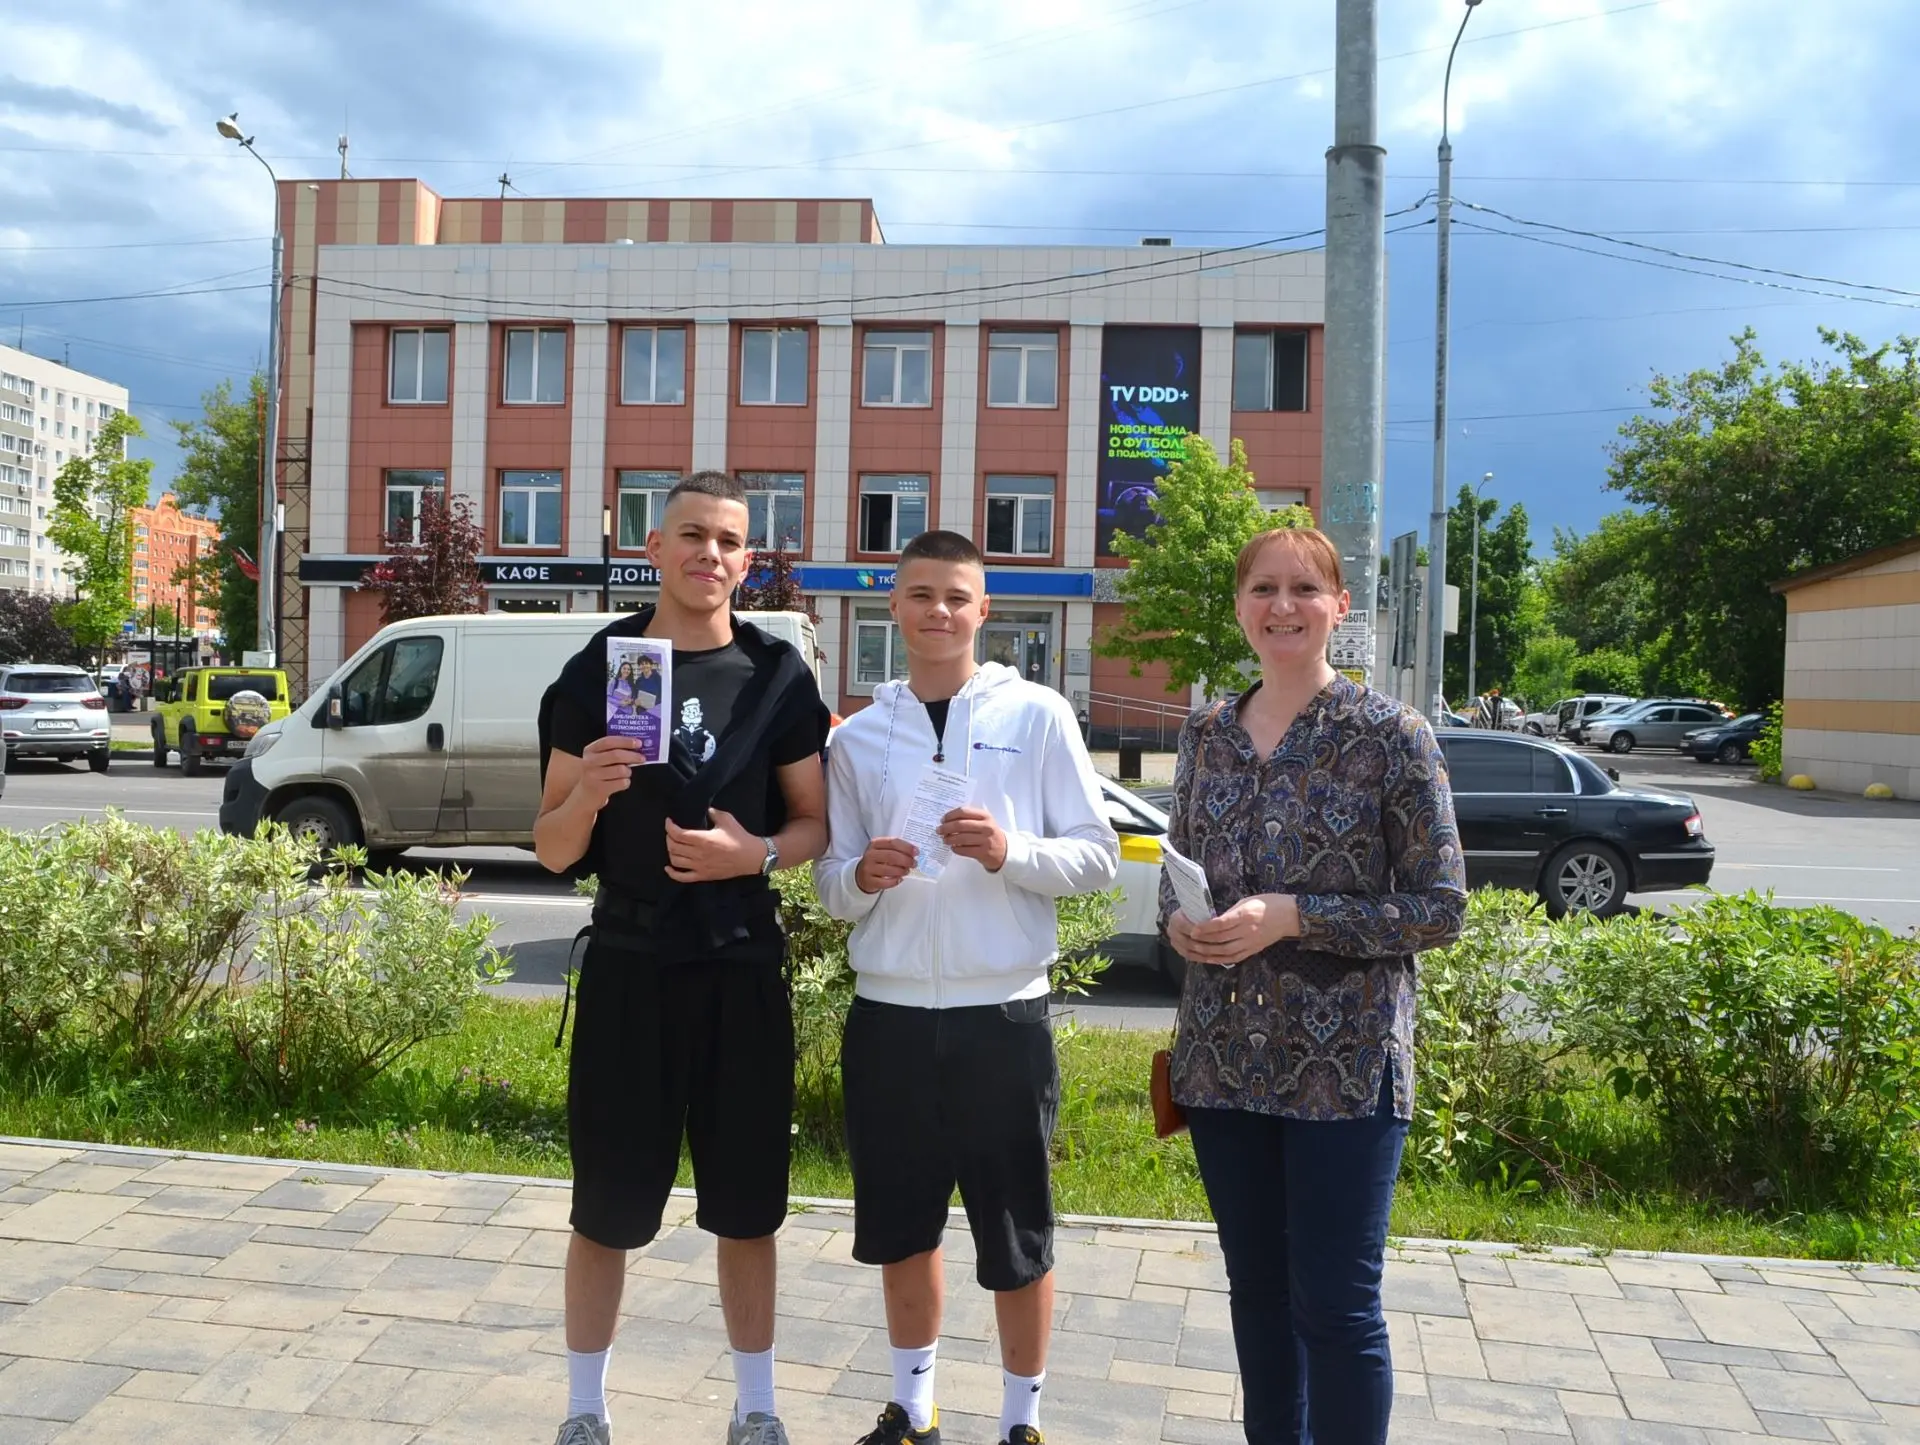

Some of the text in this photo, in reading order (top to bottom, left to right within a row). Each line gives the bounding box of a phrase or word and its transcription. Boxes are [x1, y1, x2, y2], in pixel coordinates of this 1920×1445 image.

[1110, 386, 1190, 403] TV DDD+
[1109, 424, 1187, 435] НОВОЕ МЕДИА
[1109, 436, 1121, 448] О
[1108, 449, 1188, 459] В ПОДМОСКОВЬЕ
[496, 566, 550, 580] КАФЕ
[609, 567, 662, 583] ДОНЕ
[1342, 612, 1367, 623] АБОТА
